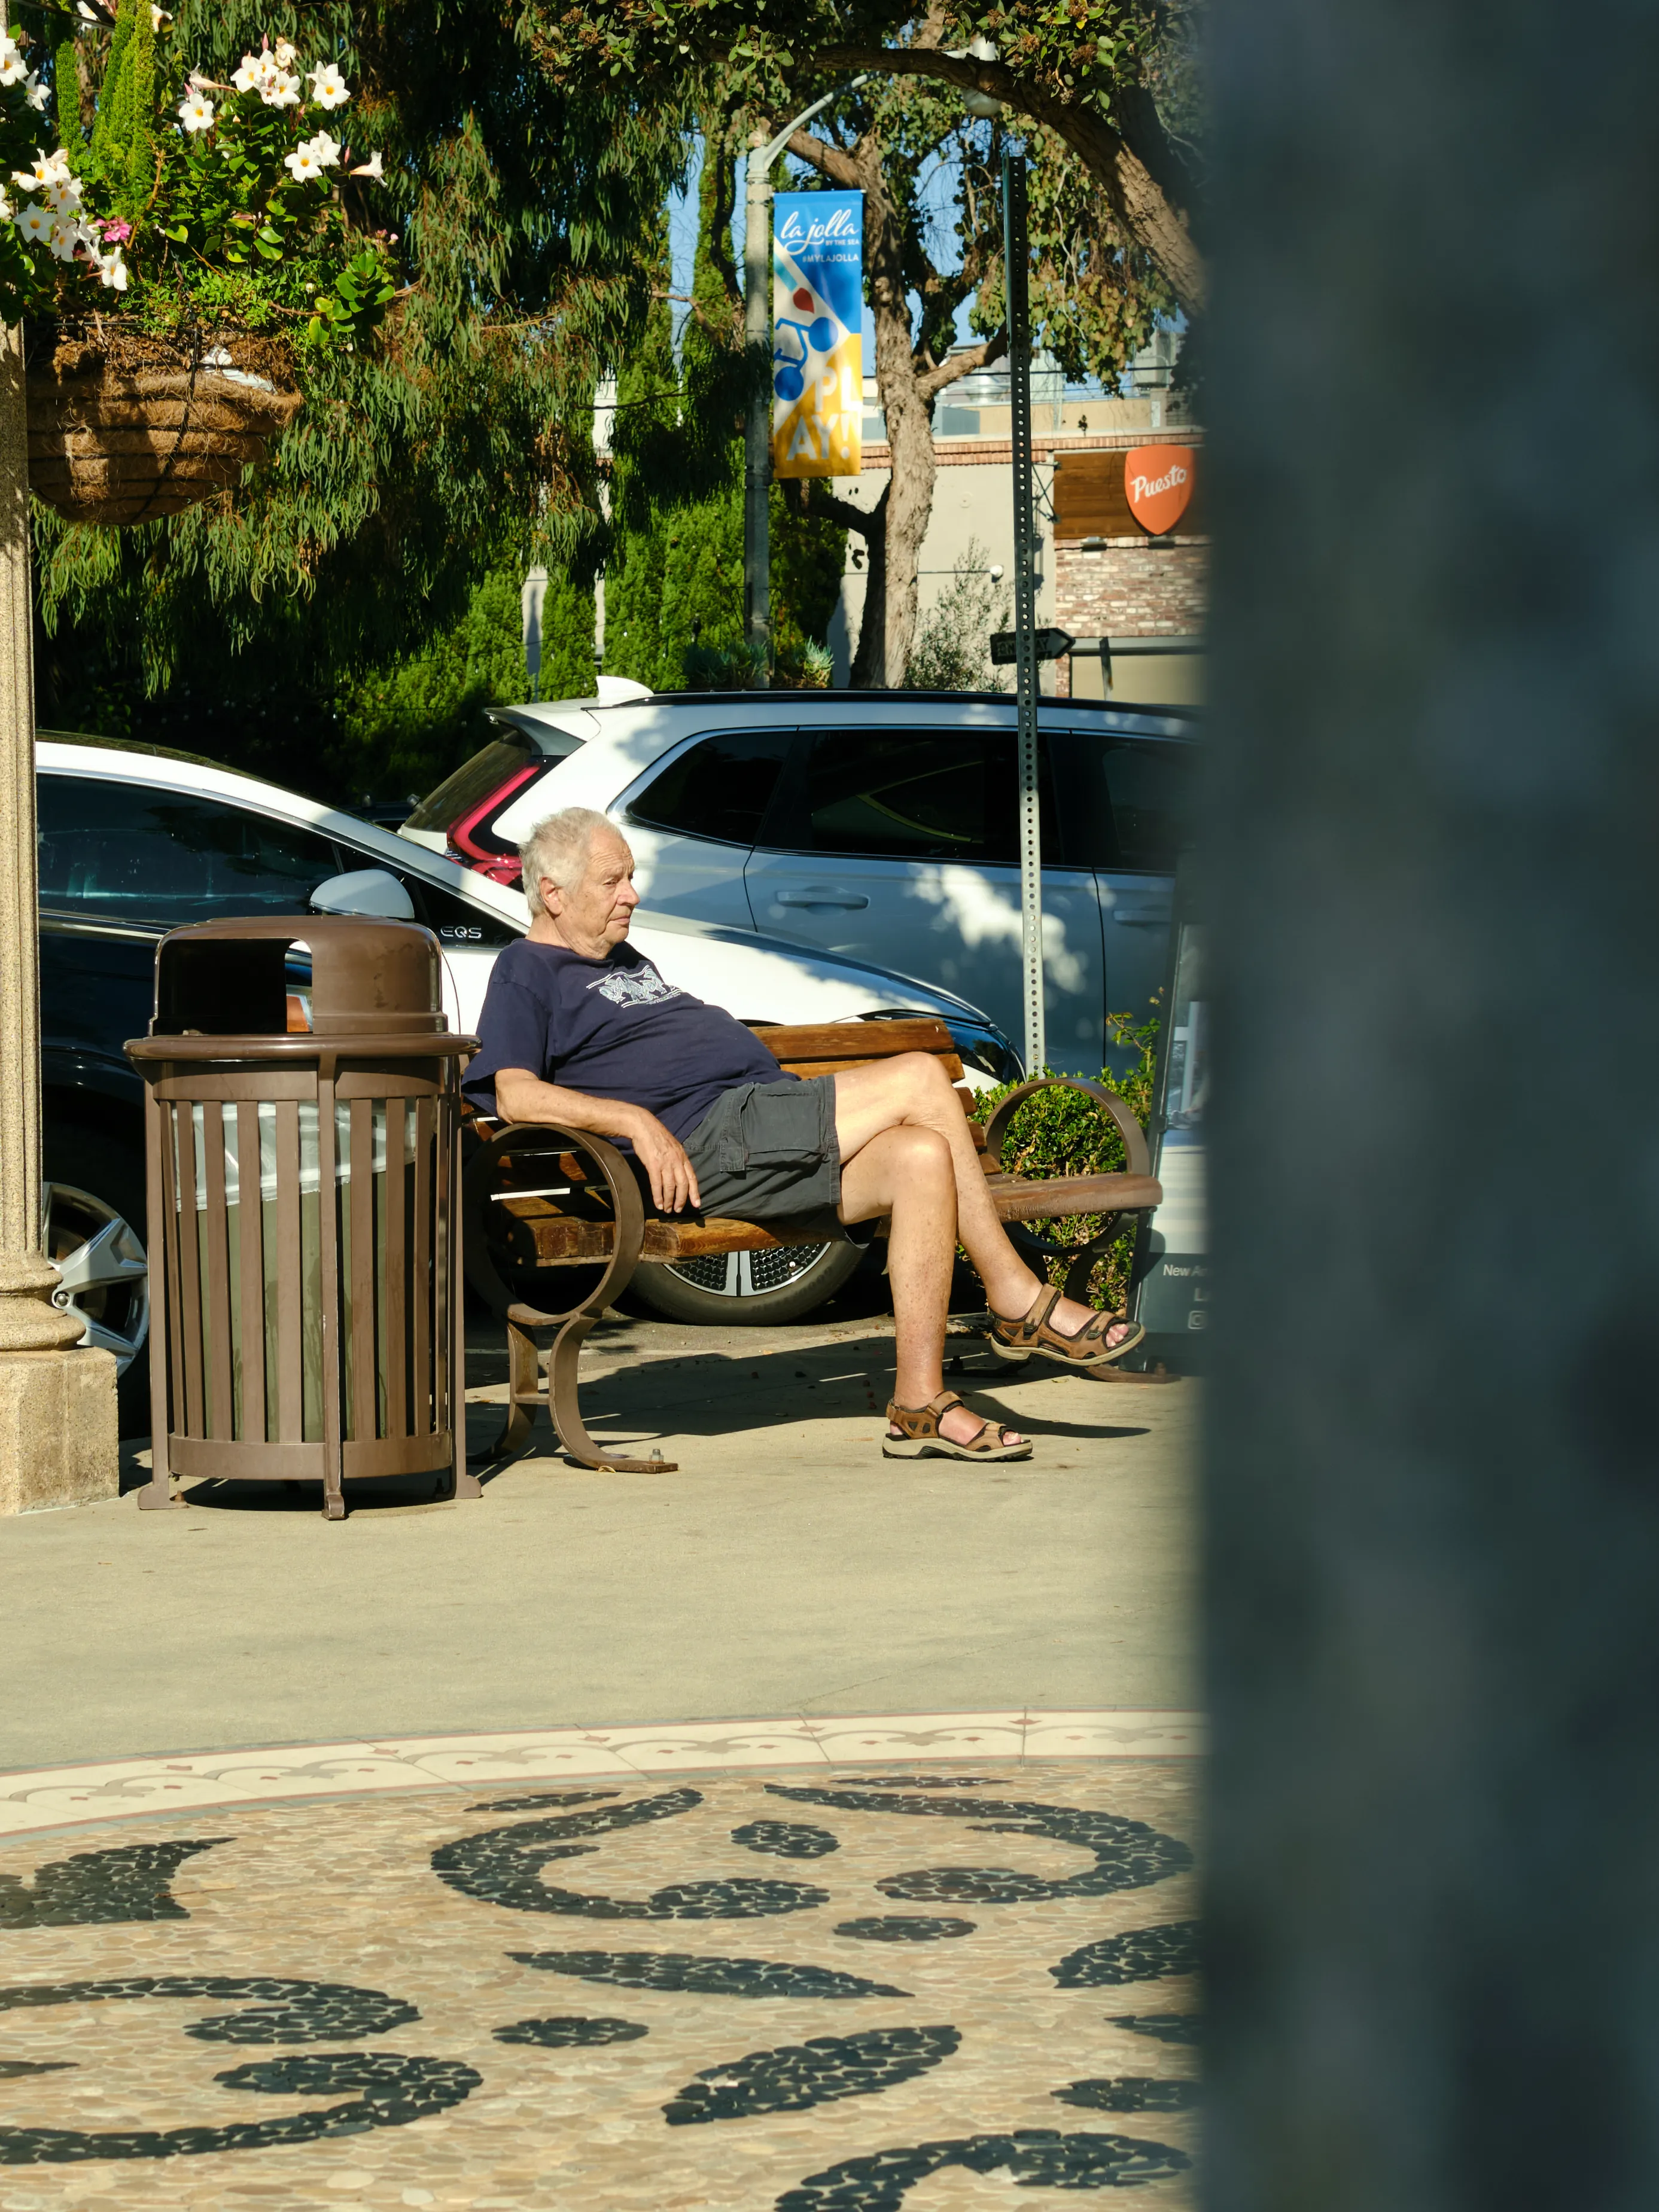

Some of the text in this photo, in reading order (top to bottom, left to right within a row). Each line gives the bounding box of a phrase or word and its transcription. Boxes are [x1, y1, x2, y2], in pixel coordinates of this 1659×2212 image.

[781, 209, 860, 255] la jolla
[802, 254, 859, 263] #MYLAJOLLA
[1130, 464, 1187, 503] Puesto
[440, 926, 482, 939] EQS
[1163, 1264, 1191, 1276] New
